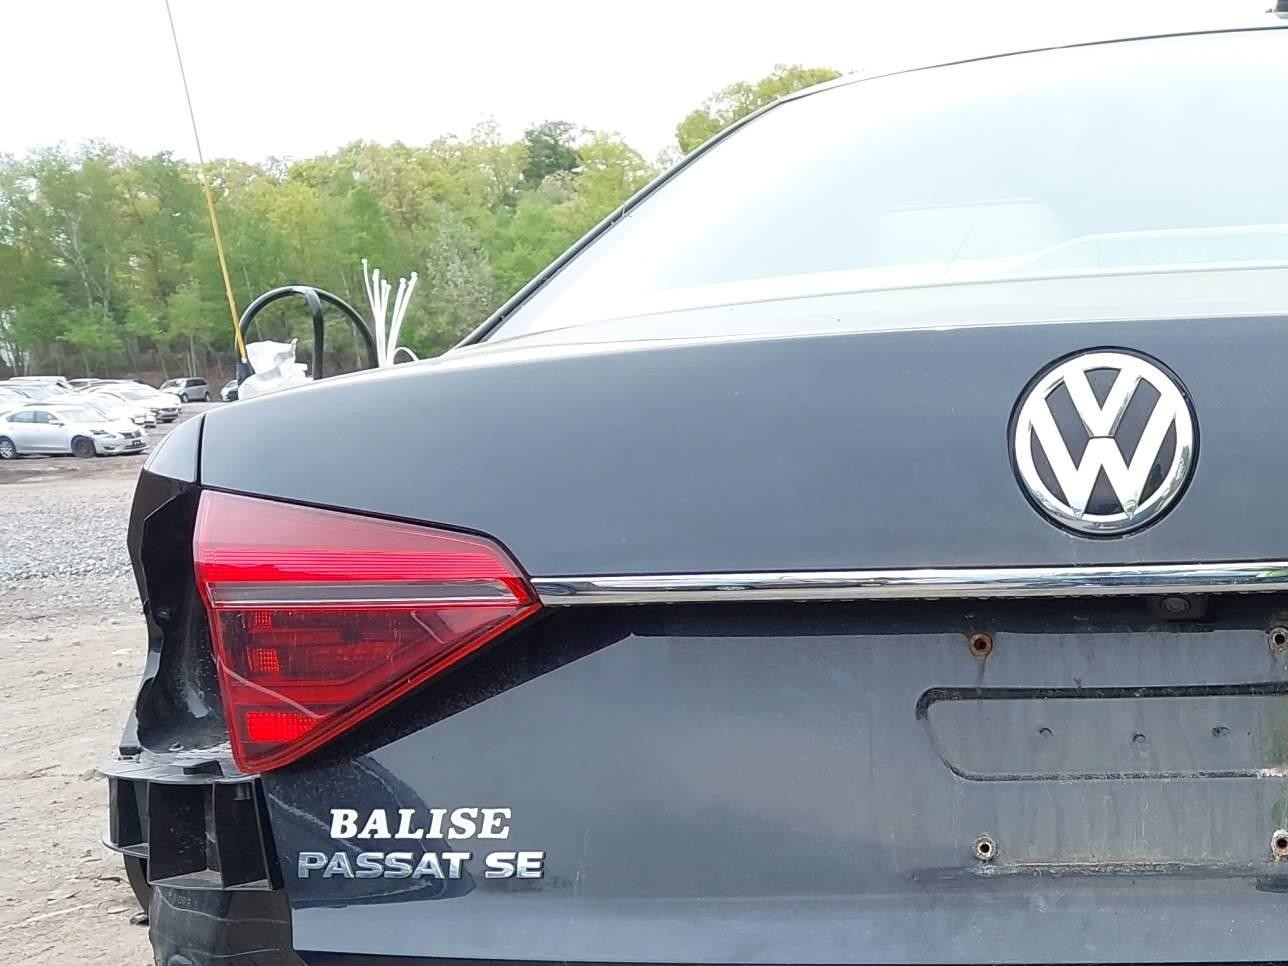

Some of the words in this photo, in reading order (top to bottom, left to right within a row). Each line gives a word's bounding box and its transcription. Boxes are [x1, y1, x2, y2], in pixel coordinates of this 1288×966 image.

[1014, 352, 1194, 529] VW
[330, 807, 512, 840] BALISE
[297, 850, 472, 879] PASSAT
[484, 850, 546, 879] SE
